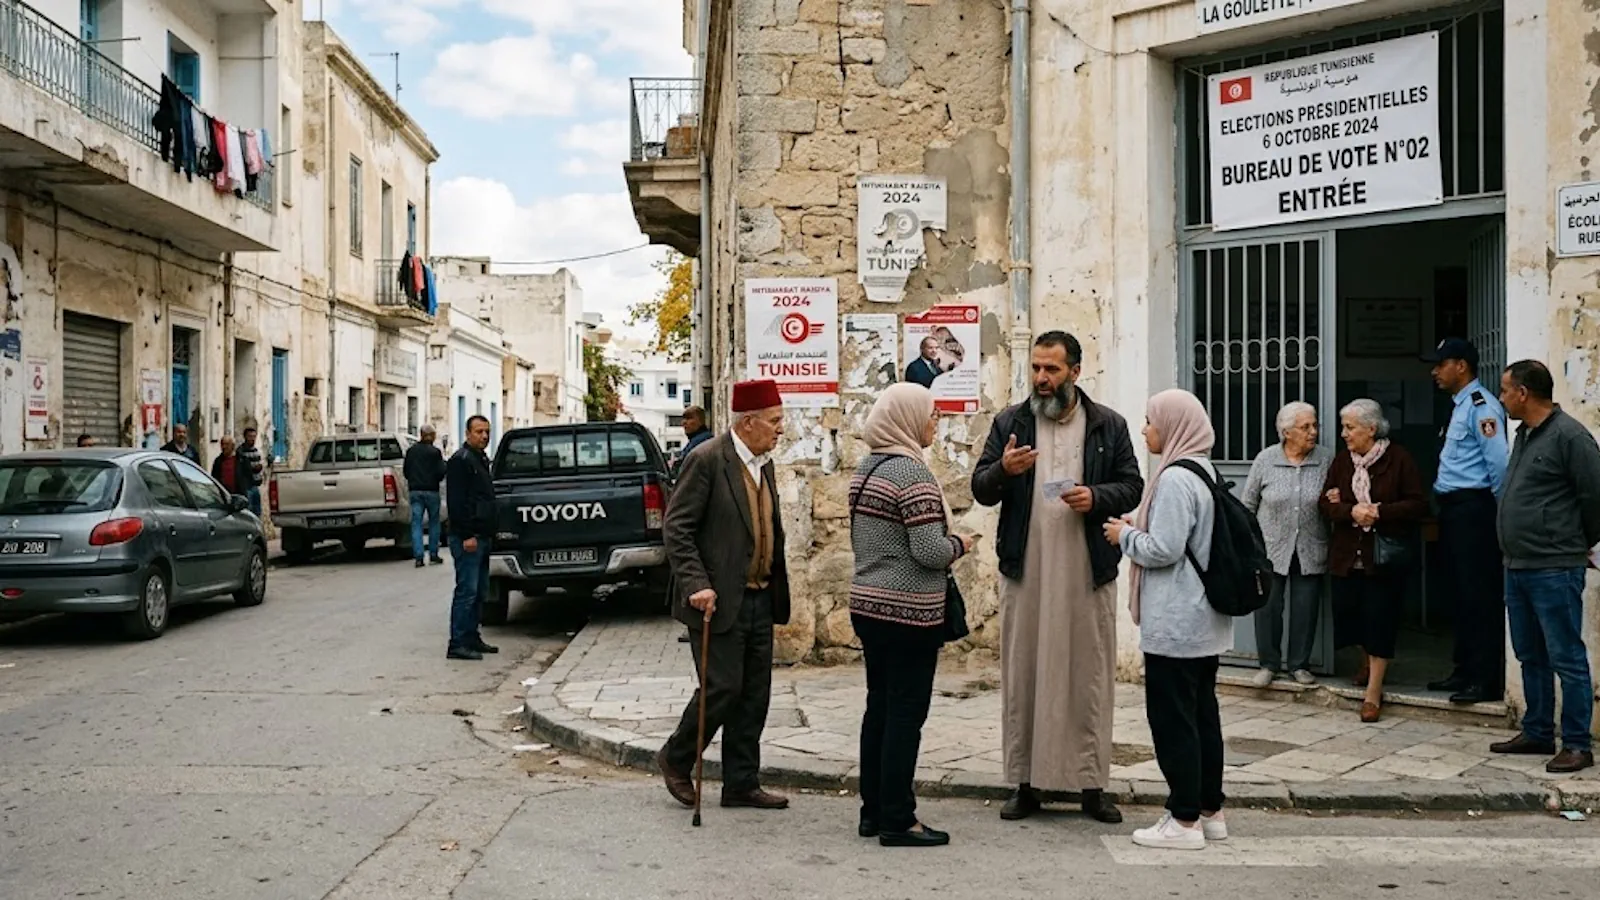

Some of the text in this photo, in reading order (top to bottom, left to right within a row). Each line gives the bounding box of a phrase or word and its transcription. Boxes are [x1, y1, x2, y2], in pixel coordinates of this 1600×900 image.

[1203, 6, 1220, 24] LA
[1320, 53, 1375, 73] TUNISIENNE
[1221, 85, 1429, 135] ELECTIONS PRESIDENTIELLES
[1263, 116, 1379, 149] 6 OCTOBRE 2024
[1222, 136, 1430, 187] BUREAU DE VOTE N°02
[882, 192, 922, 204] 2024
[1279, 177, 1367, 214] ENTRÉE
[1568, 214, 1600, 229] ÉCOL
[772, 296, 811, 307] 2024
[757, 363, 829, 376] TUNISIE
[516, 502, 607, 523] TOYOTA
